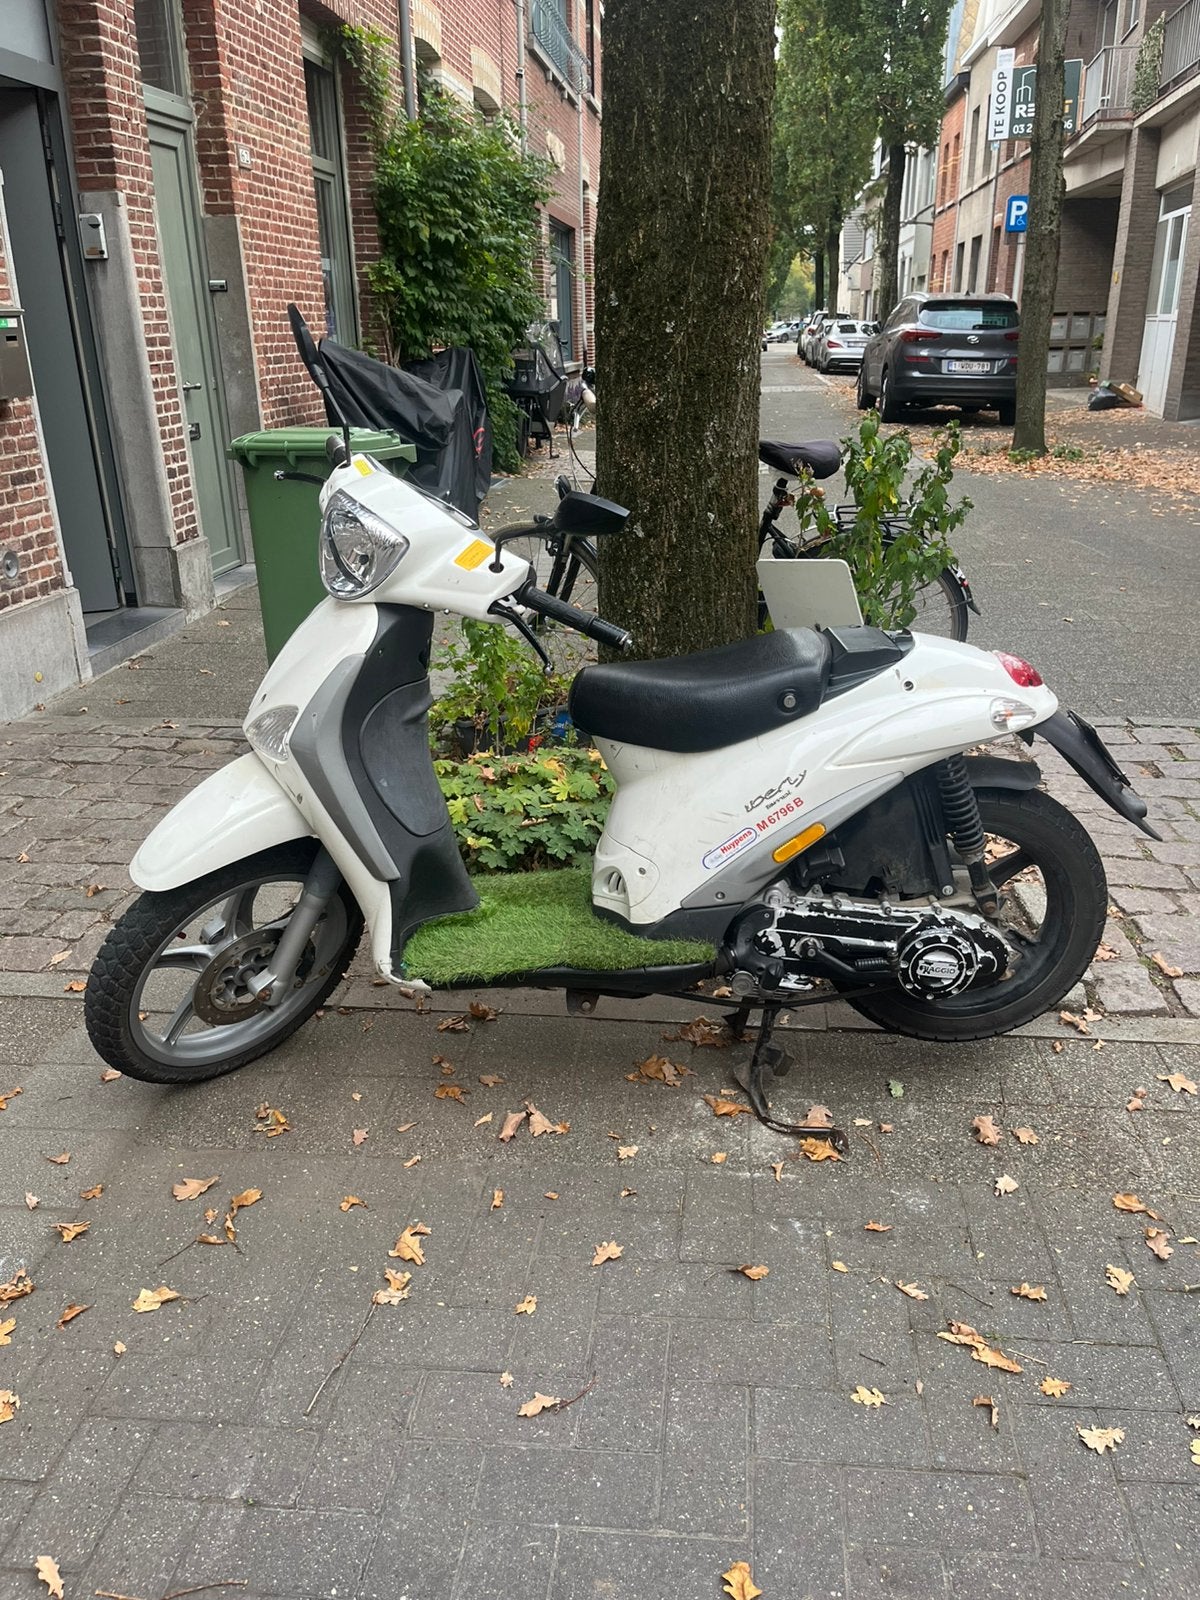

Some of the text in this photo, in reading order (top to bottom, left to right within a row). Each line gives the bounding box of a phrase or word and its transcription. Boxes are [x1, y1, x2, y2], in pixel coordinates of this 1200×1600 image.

[995, 71, 1007, 115] KOOP
[993, 119, 1005, 137] TE
[1012, 124, 1025, 134] 03
[1009, 201, 1028, 226] P
[756, 820, 769, 831] M
[767, 803, 795, 824] 6796
[793, 797, 804, 808] B
[720, 830, 752, 854] Huypens
